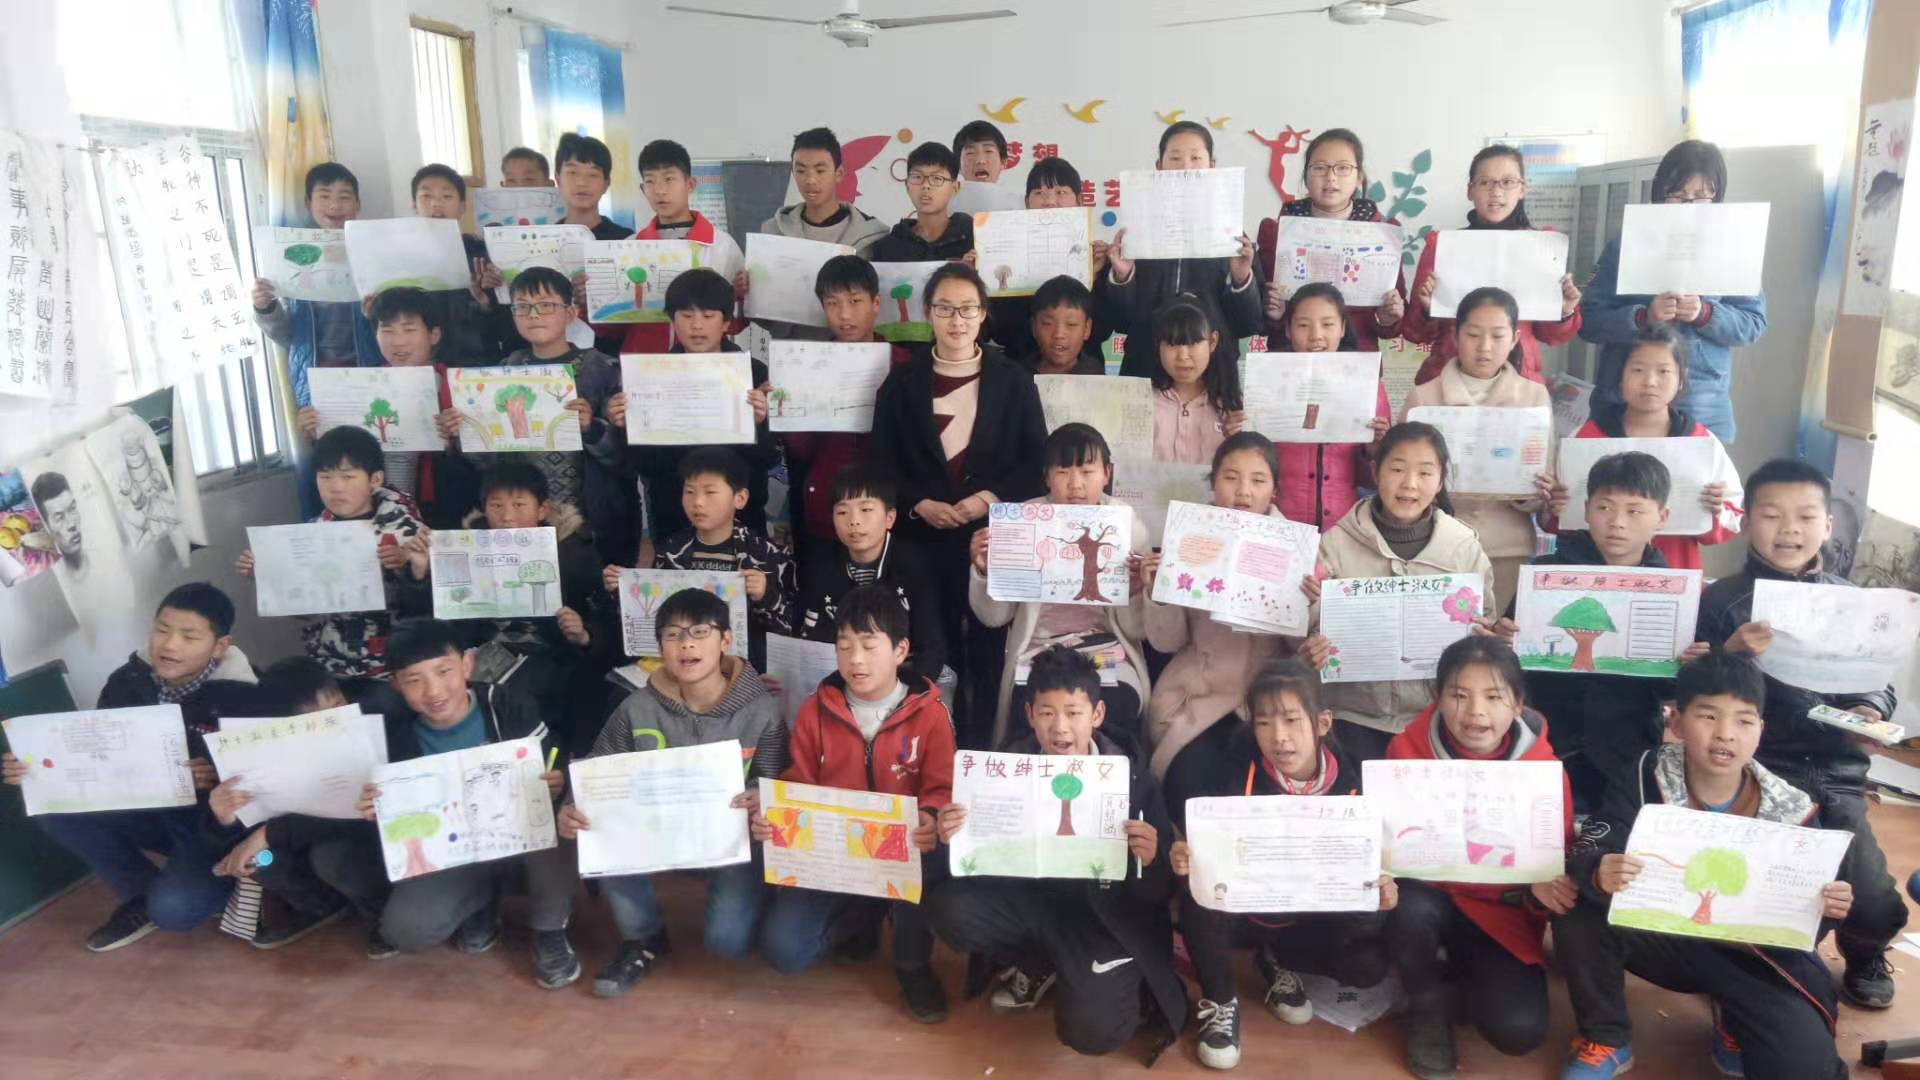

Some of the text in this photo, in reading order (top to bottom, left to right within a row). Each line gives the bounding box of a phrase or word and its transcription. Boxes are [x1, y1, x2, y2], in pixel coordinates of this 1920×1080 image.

[1351, 579, 1441, 596] 争做绅士淑女
[961, 754, 1114, 781] 争做绅士淑女
